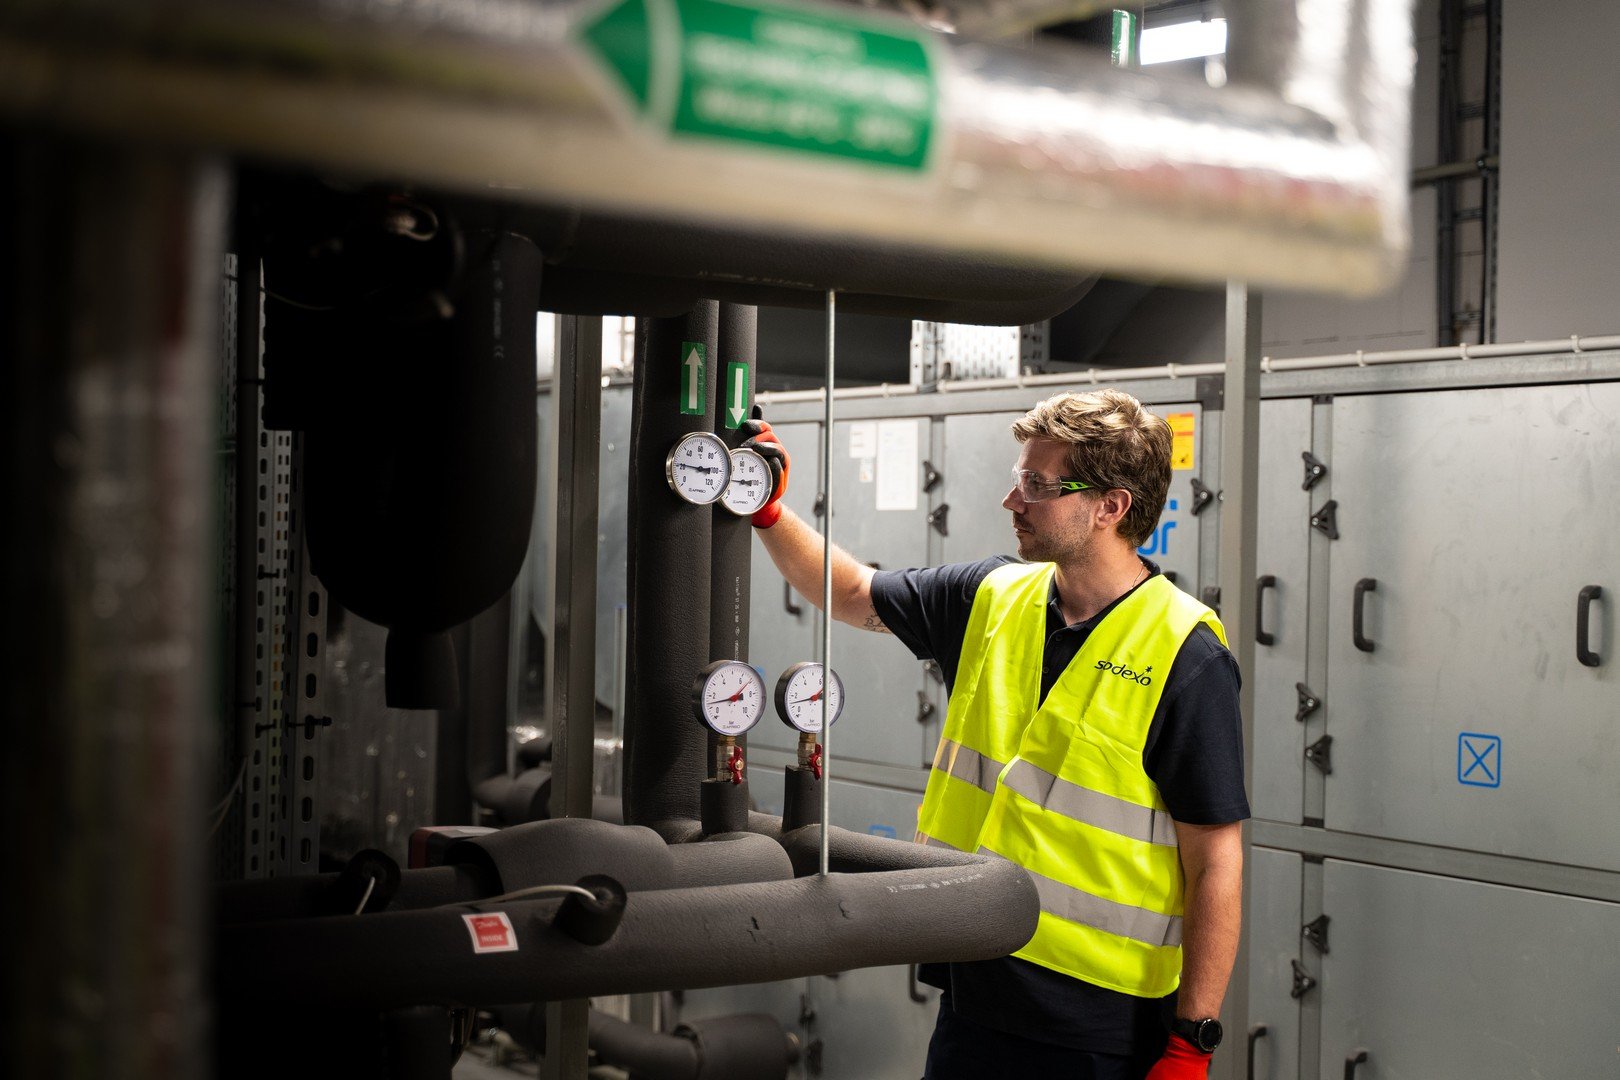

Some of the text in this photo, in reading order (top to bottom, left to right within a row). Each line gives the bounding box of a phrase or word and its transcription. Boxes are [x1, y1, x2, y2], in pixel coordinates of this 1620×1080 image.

[1094, 660, 1152, 686] sodexo
[749, 690, 753, 698] 8
[715, 706, 720, 714] 0
[742, 706, 748, 714] 10
